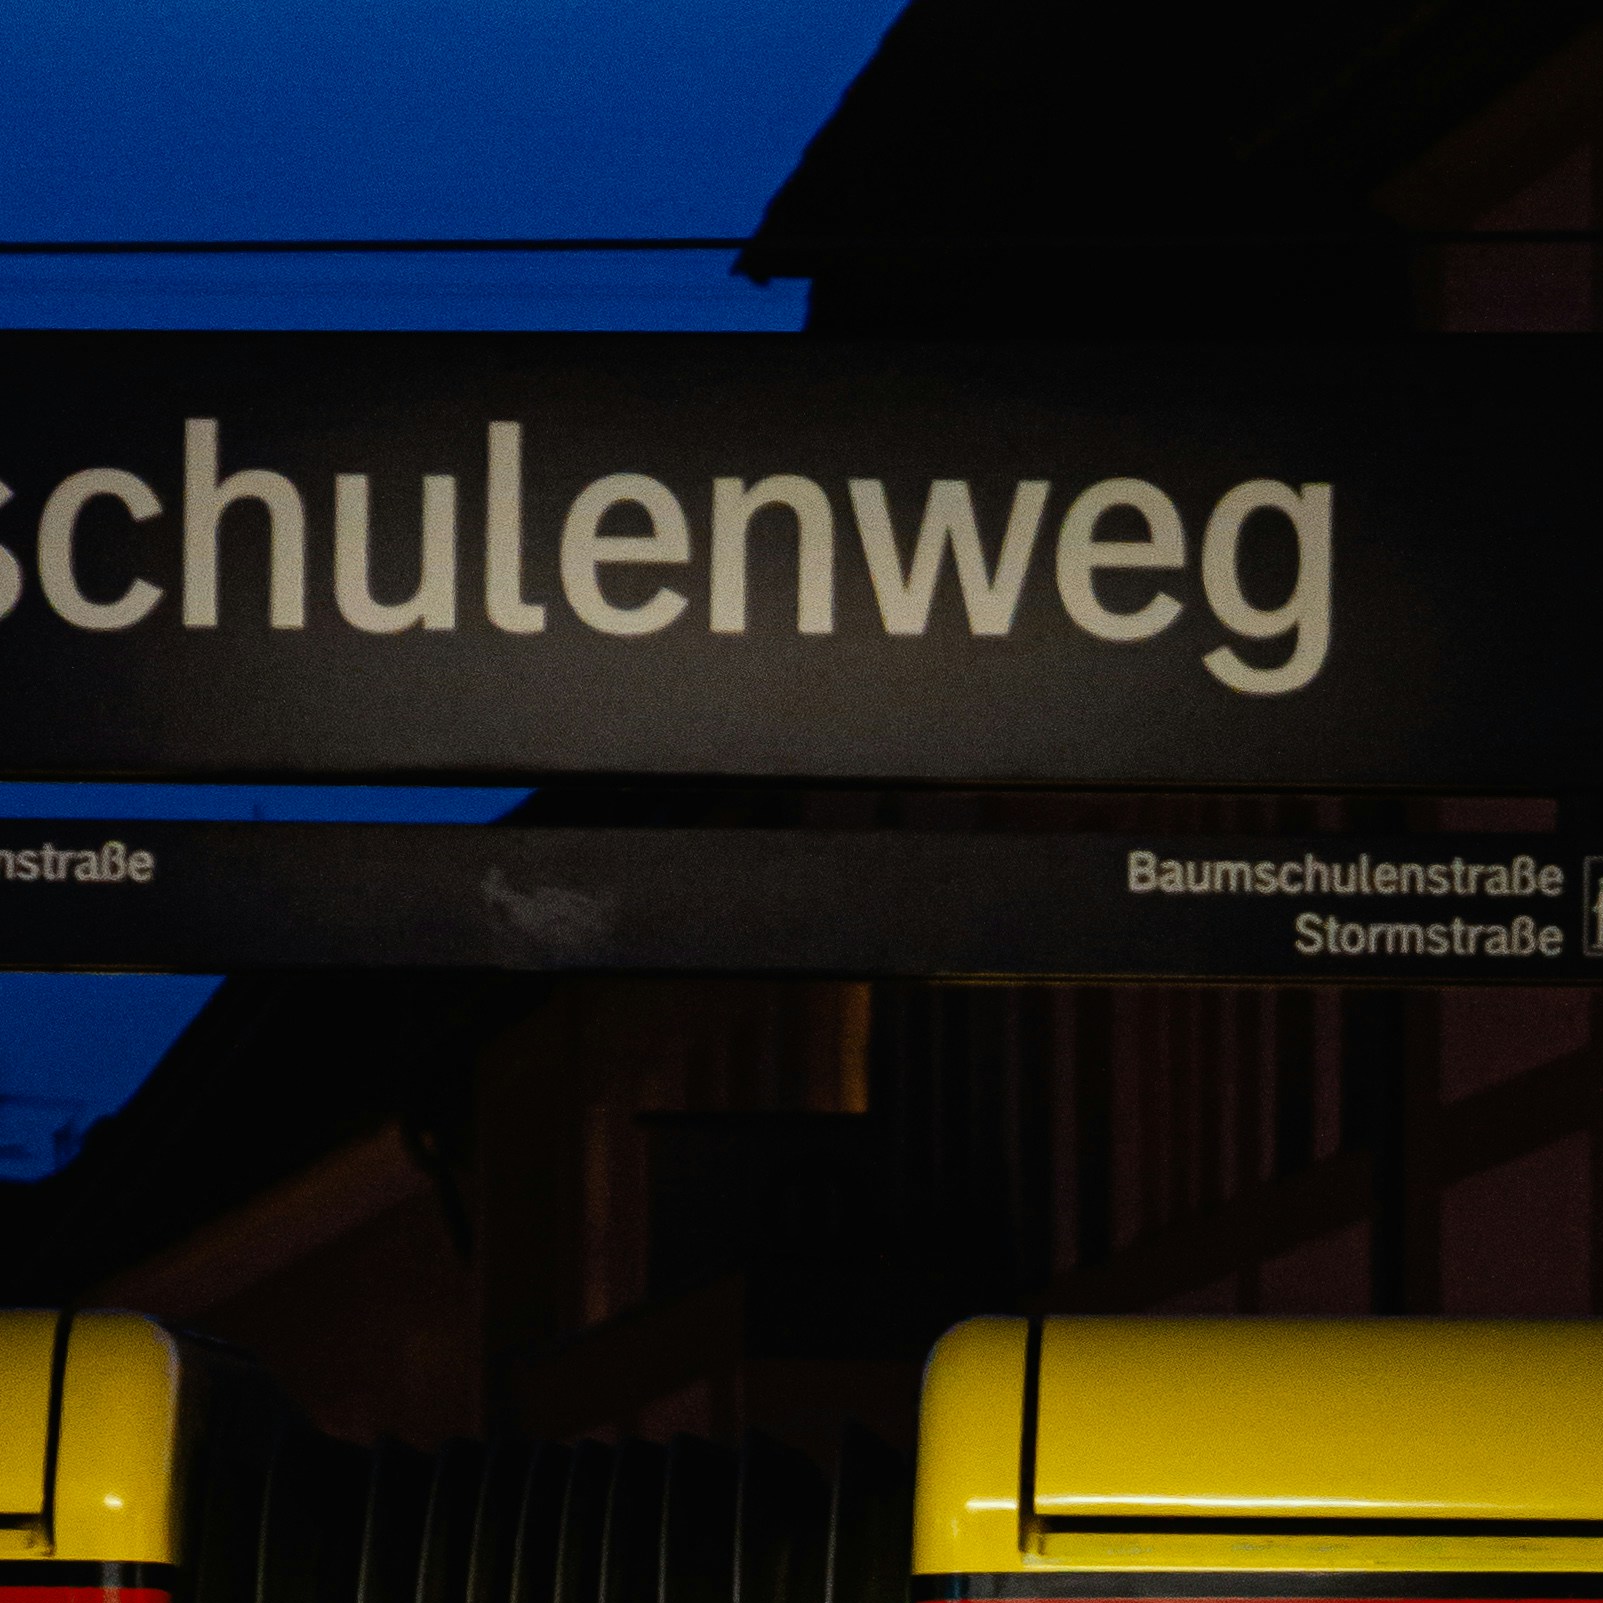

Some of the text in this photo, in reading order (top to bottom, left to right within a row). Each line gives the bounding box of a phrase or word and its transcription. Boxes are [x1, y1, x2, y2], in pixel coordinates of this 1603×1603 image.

[0, 417, 1334, 697] chulenweg
[1127, 850, 1564, 895] Baumschulenstraße
[1295, 912, 1564, 956] Stormstraße
